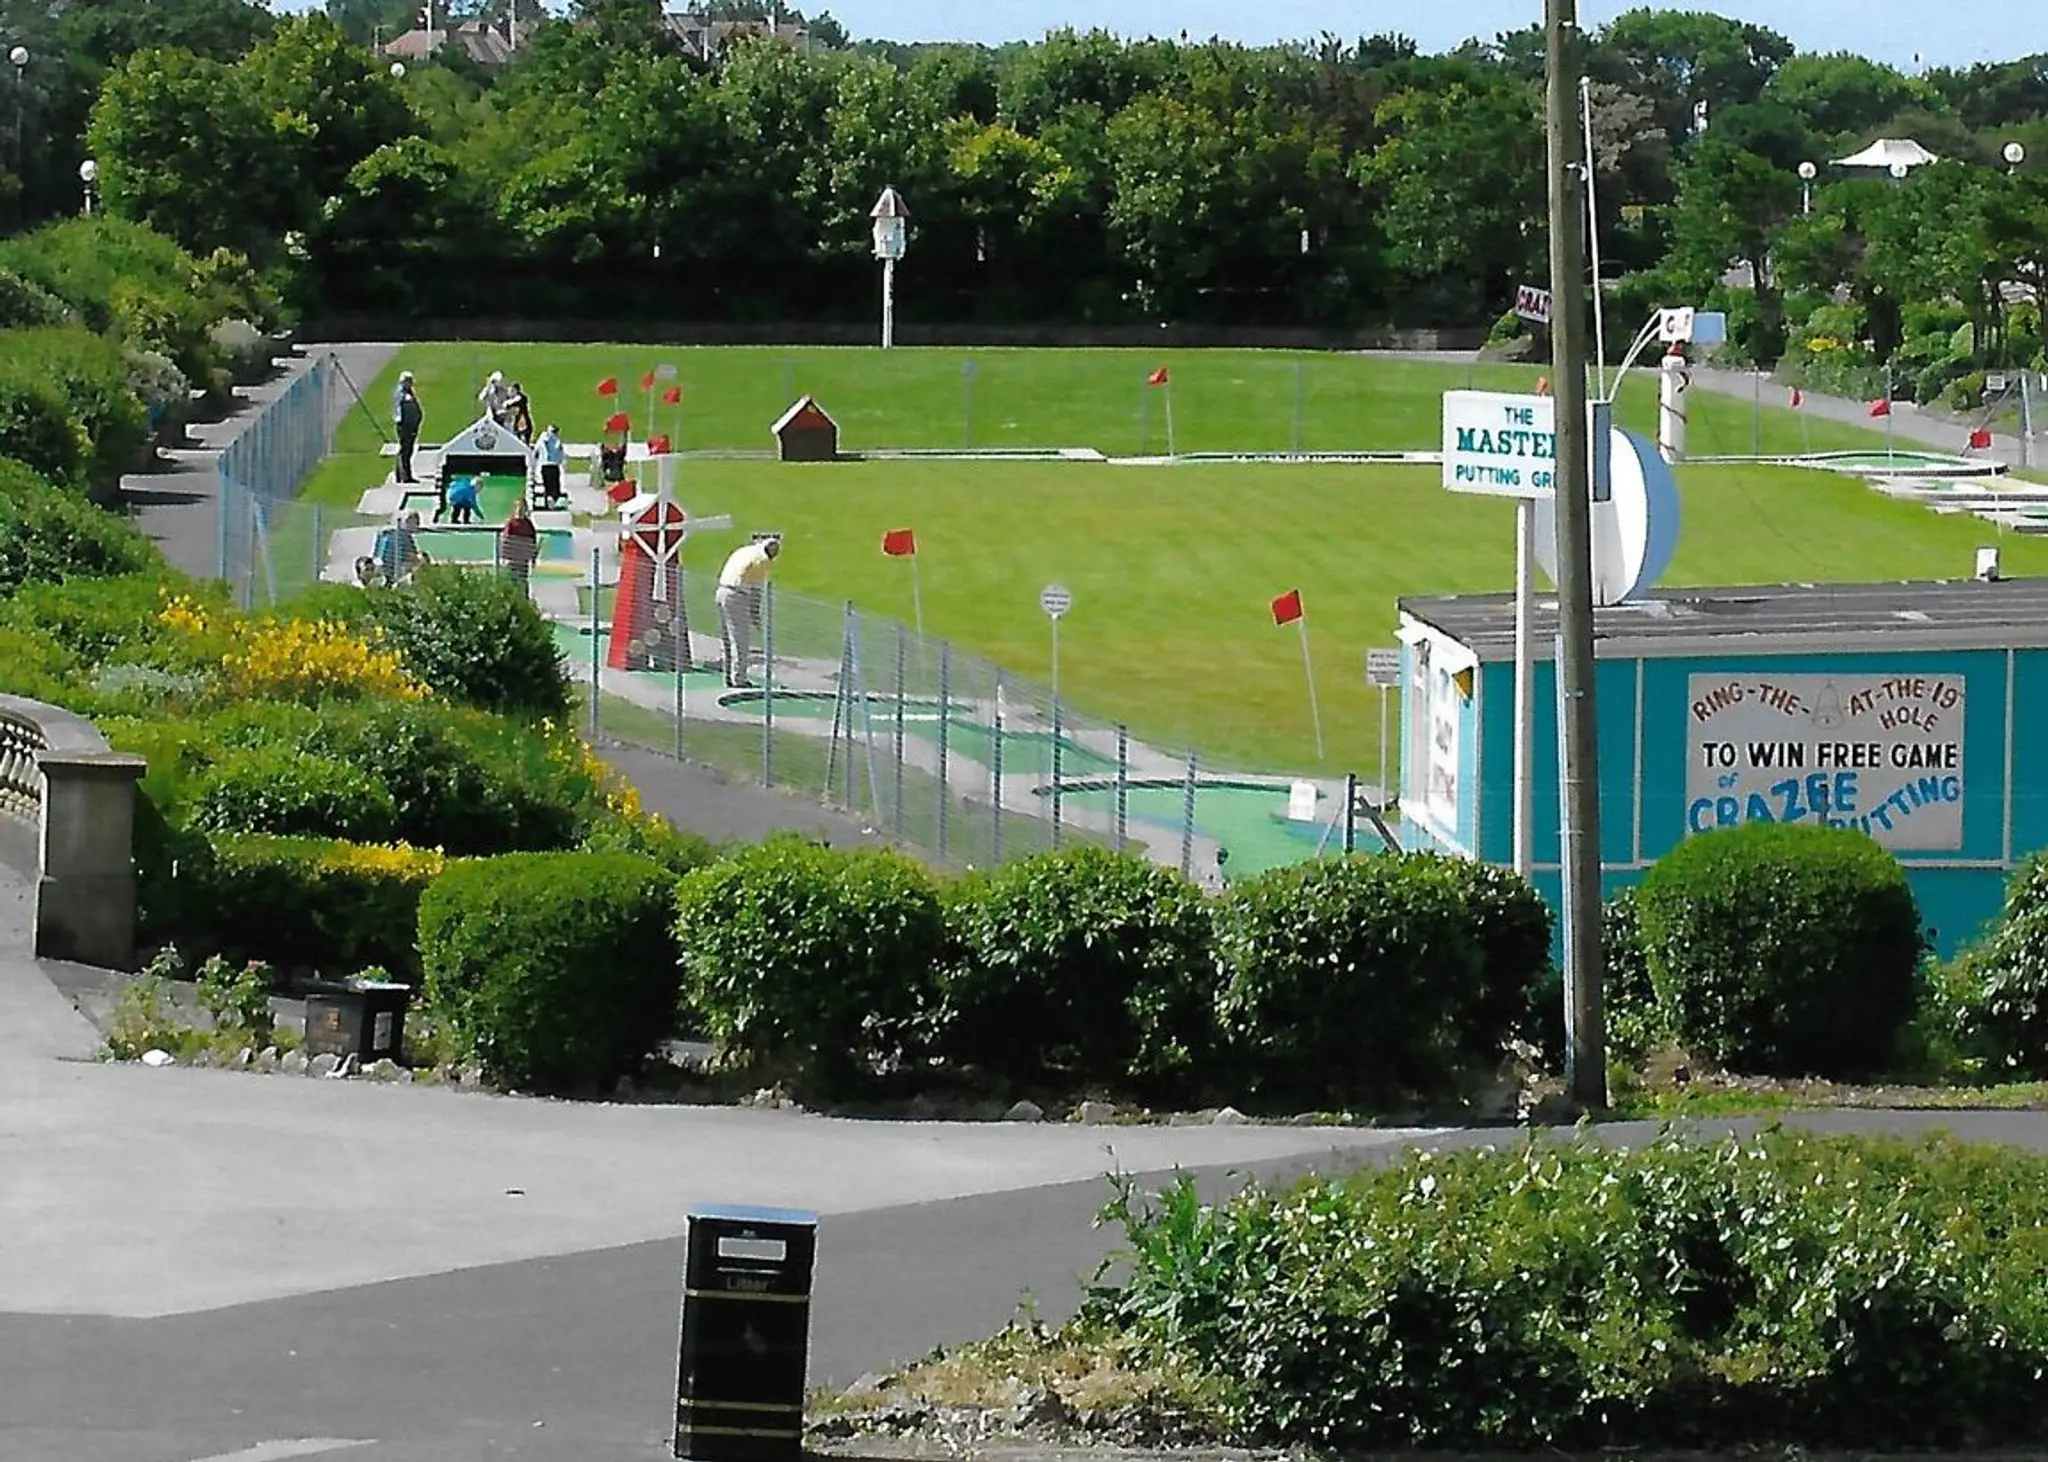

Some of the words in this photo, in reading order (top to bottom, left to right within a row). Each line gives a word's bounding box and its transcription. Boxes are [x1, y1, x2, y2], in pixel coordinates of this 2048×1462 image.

[1505, 407, 1534, 425] THE
[1456, 464, 1520, 485] PUTTING
[1531, 471, 1556, 489] GR
[1879, 706, 1939, 733] HOLE
[1703, 742, 1736, 768] TO
[1749, 742, 1804, 768] WIN
[1818, 742, 1881, 768] FREE
[1891, 743, 1957, 768] GAME
